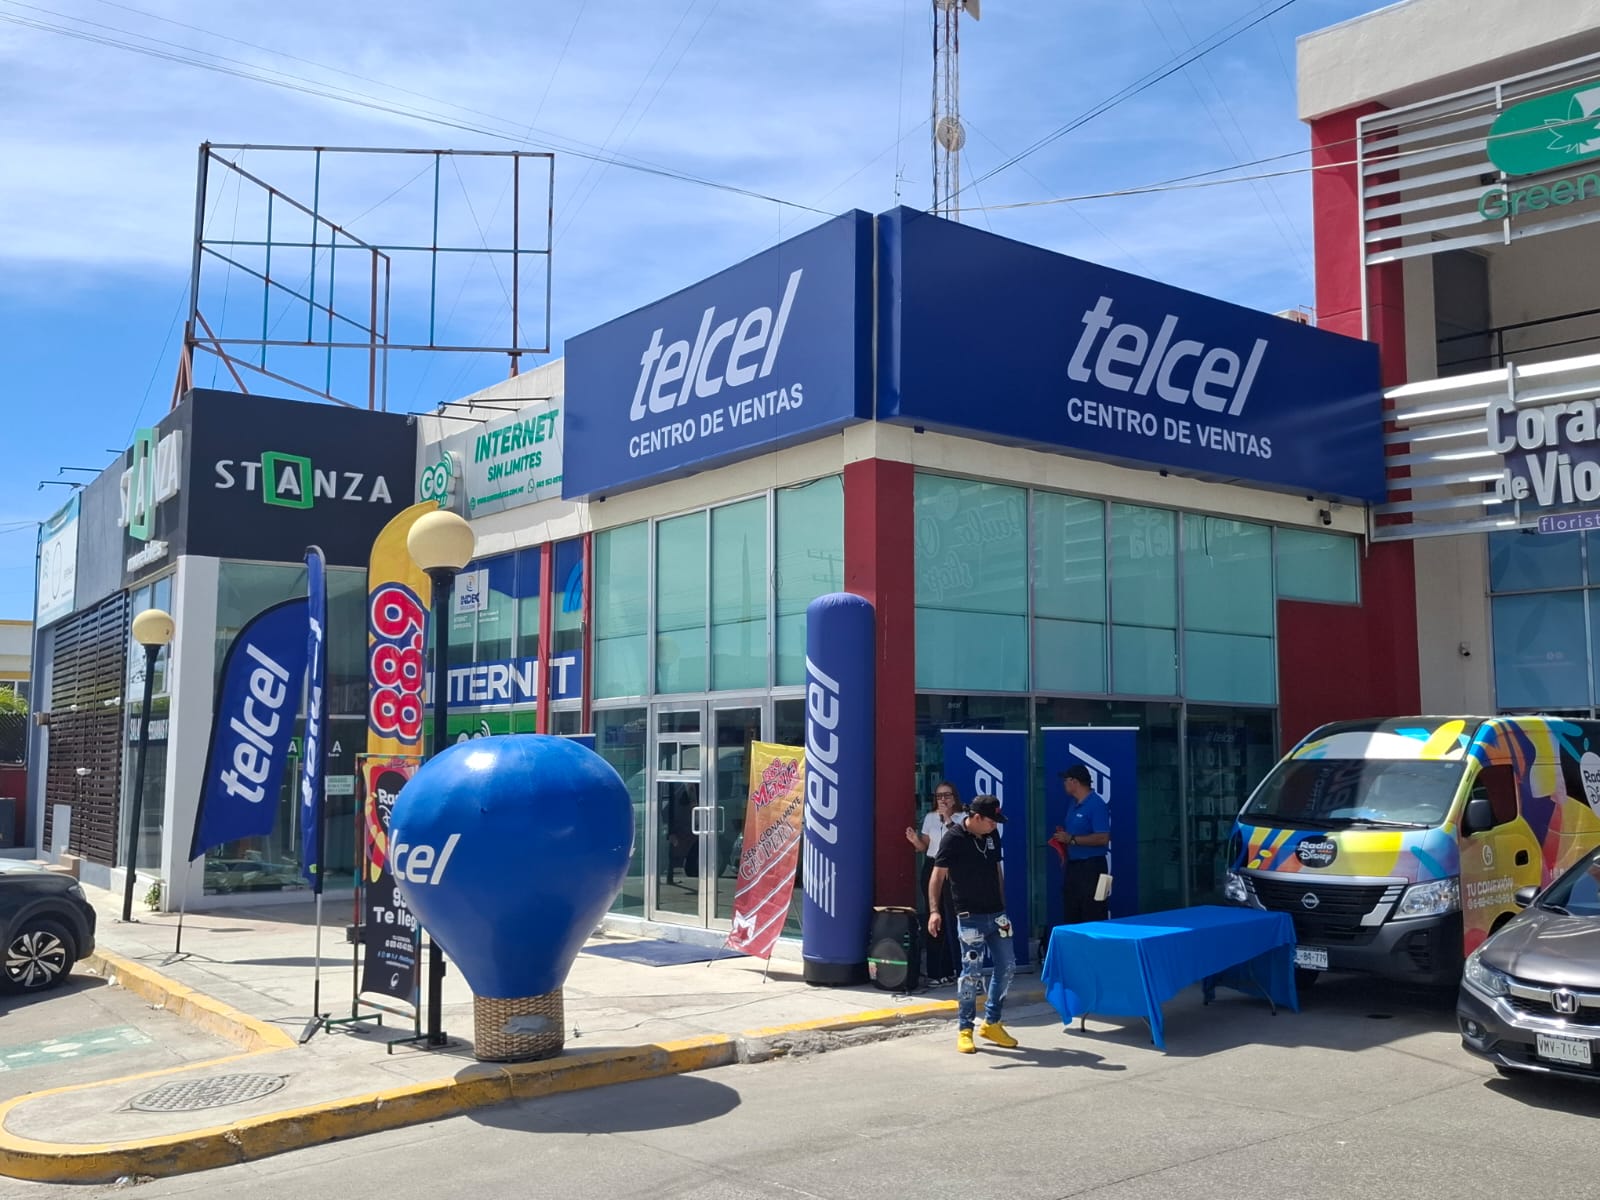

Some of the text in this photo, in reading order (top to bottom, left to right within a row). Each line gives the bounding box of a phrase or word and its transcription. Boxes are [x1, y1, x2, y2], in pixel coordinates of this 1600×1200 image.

[1478, 173, 1600, 221] Green
[630, 268, 803, 422] telcel
[1067, 295, 1269, 417] telcel
[474, 409, 559, 463] INTERNET
[629, 382, 803, 458] CENTRO DE VENTAS
[1067, 398, 1272, 459] CENTRO DE VENTAS
[1486, 398, 1600, 454] Cora
[215, 459, 393, 505] STANZA
[420, 461, 448, 500] GO
[487, 450, 542, 482] SIN LIMITES
[1495, 467, 1530, 501] de
[424, 656, 576, 706] ITERNT
[220, 642, 290, 804] telcel
[804, 655, 840, 845] telcel
[1297, 848, 1332, 864] Disney
[1299, 841, 1335, 850] Radio
[1466, 882, 1477, 898] TU
[373, 906, 418, 932] Te lleg
